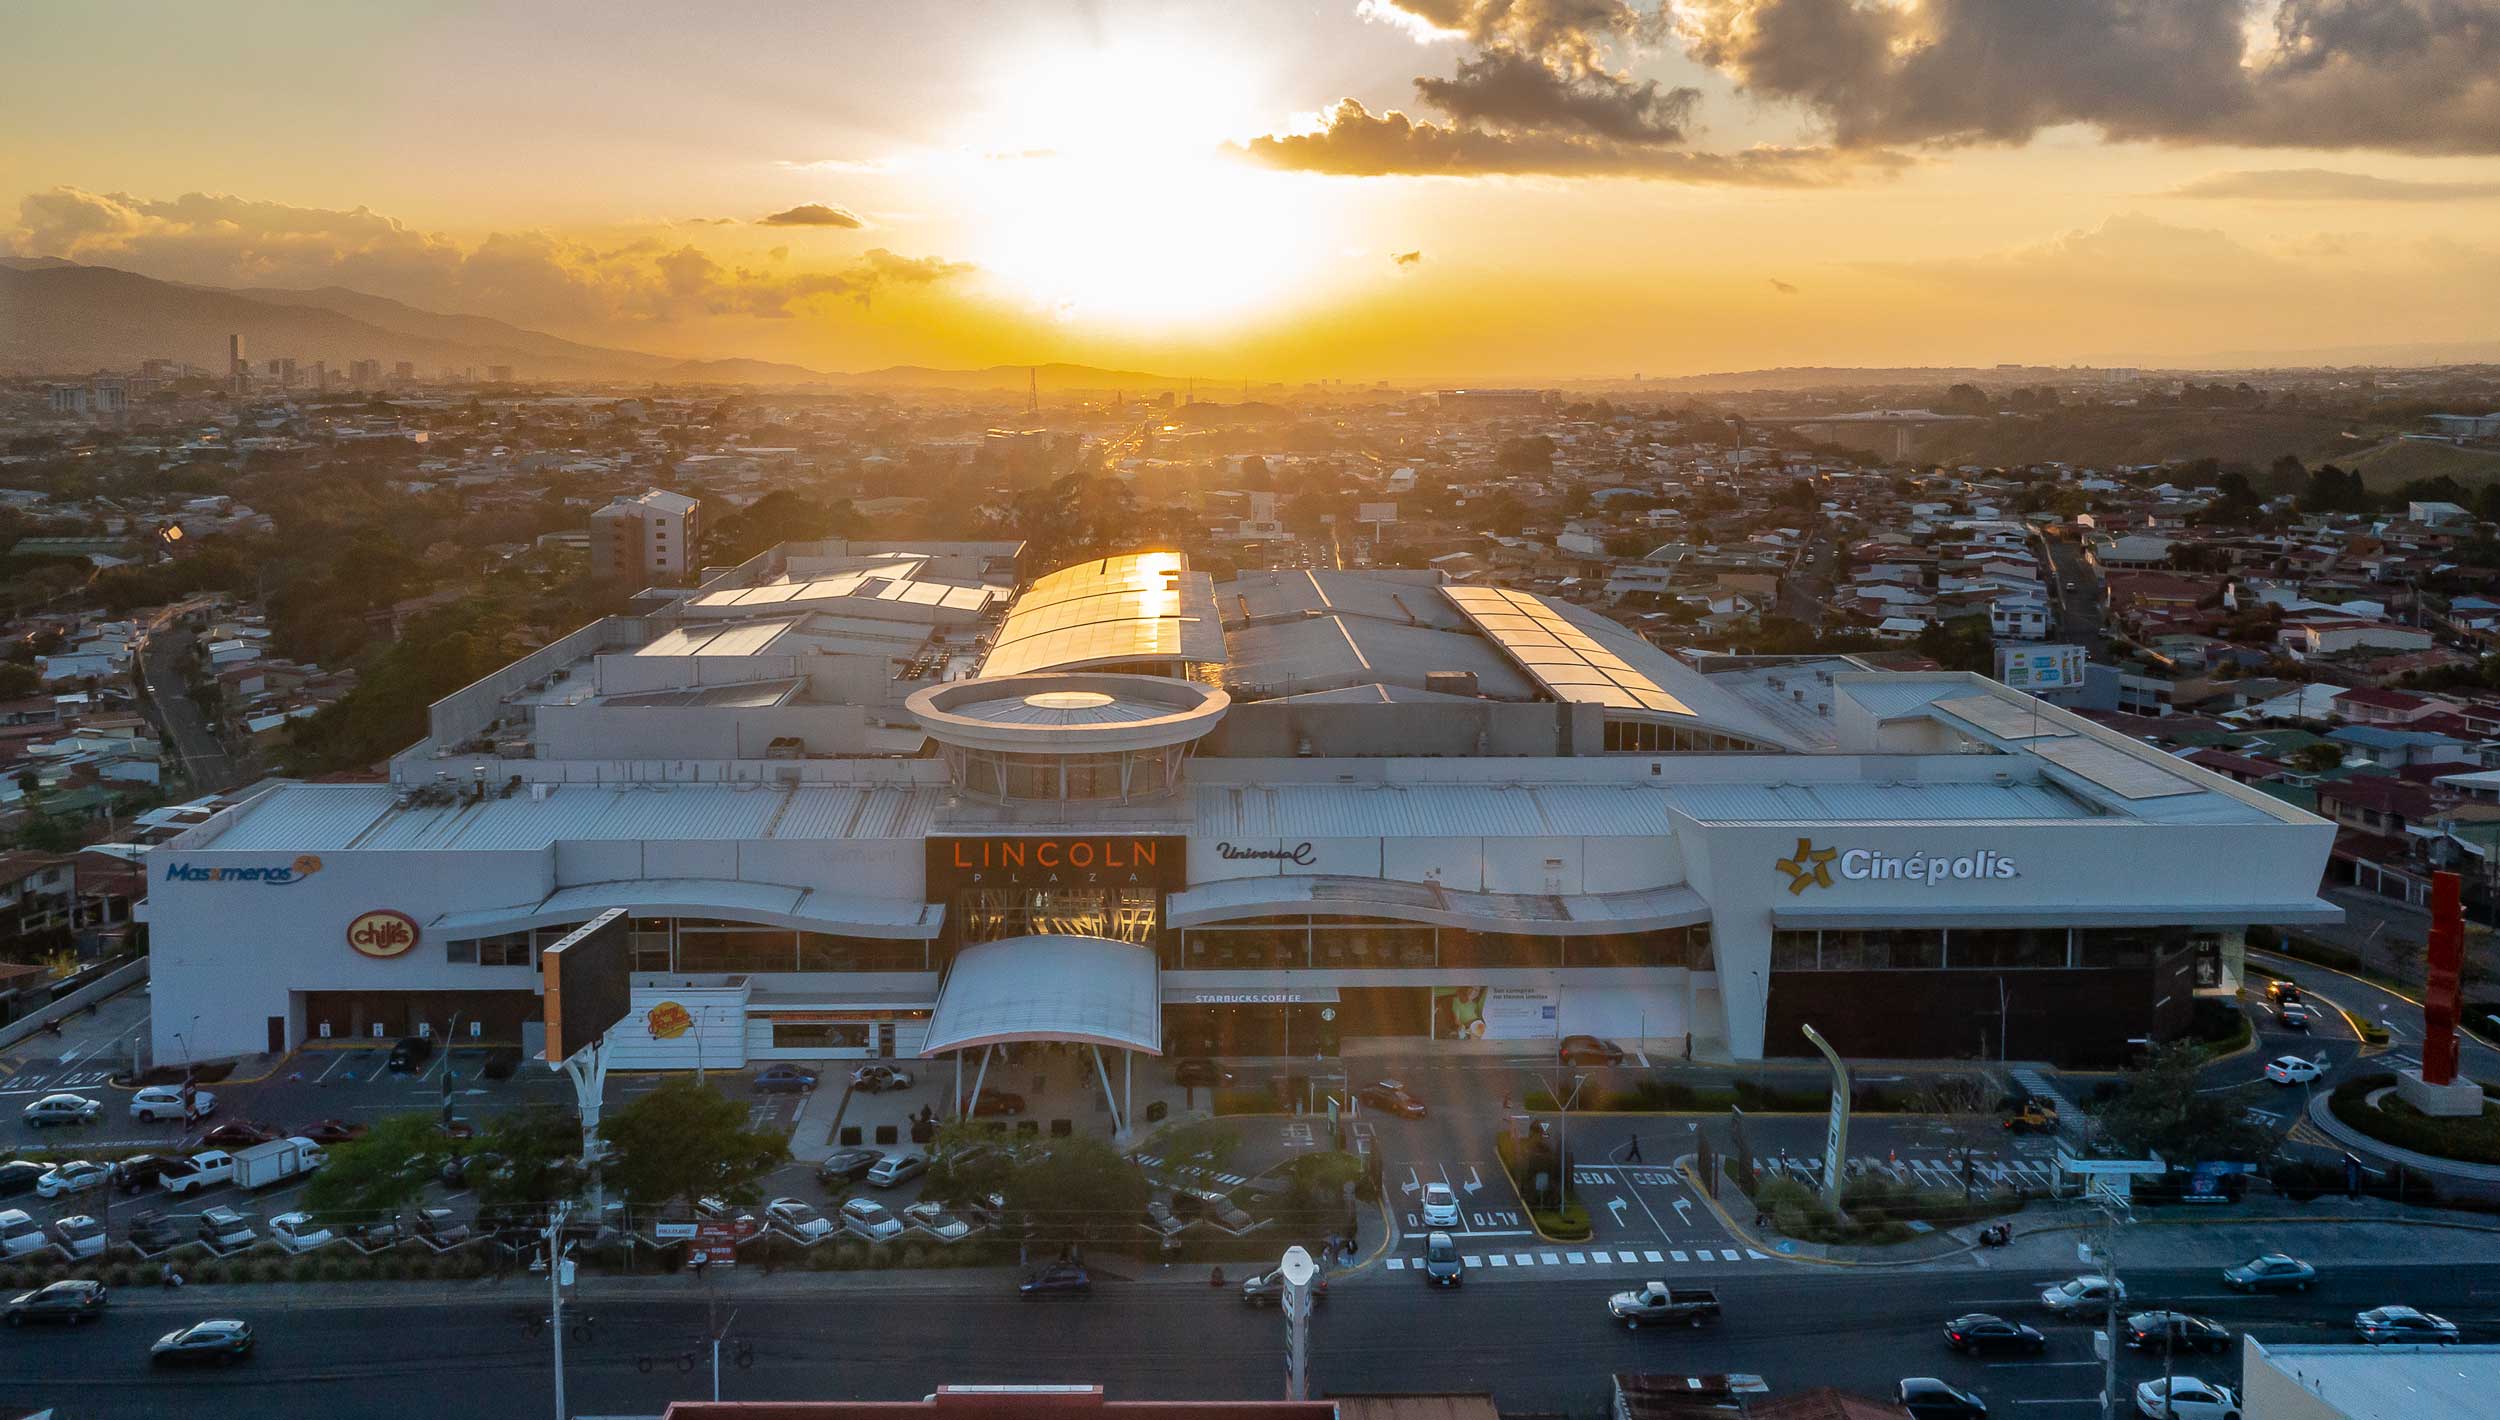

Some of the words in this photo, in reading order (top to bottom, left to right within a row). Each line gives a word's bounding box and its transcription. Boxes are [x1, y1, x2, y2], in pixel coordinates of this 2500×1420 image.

[954, 842, 1157, 868] LINCOLN
[1216, 842, 1318, 866] Universal
[1840, 848, 2016, 887] Cinépolis
[974, 873, 1138, 883] PLAZA
[354, 921, 410, 949] chili's
[1195, 994, 1259, 1003] STARBUCKS
[1261, 994, 1301, 1003] COFFEE
[1573, 1172, 1617, 1186] CEDA
[1633, 1172, 1680, 1186] CEDA
[1472, 1211, 1519, 1227] ALTO
